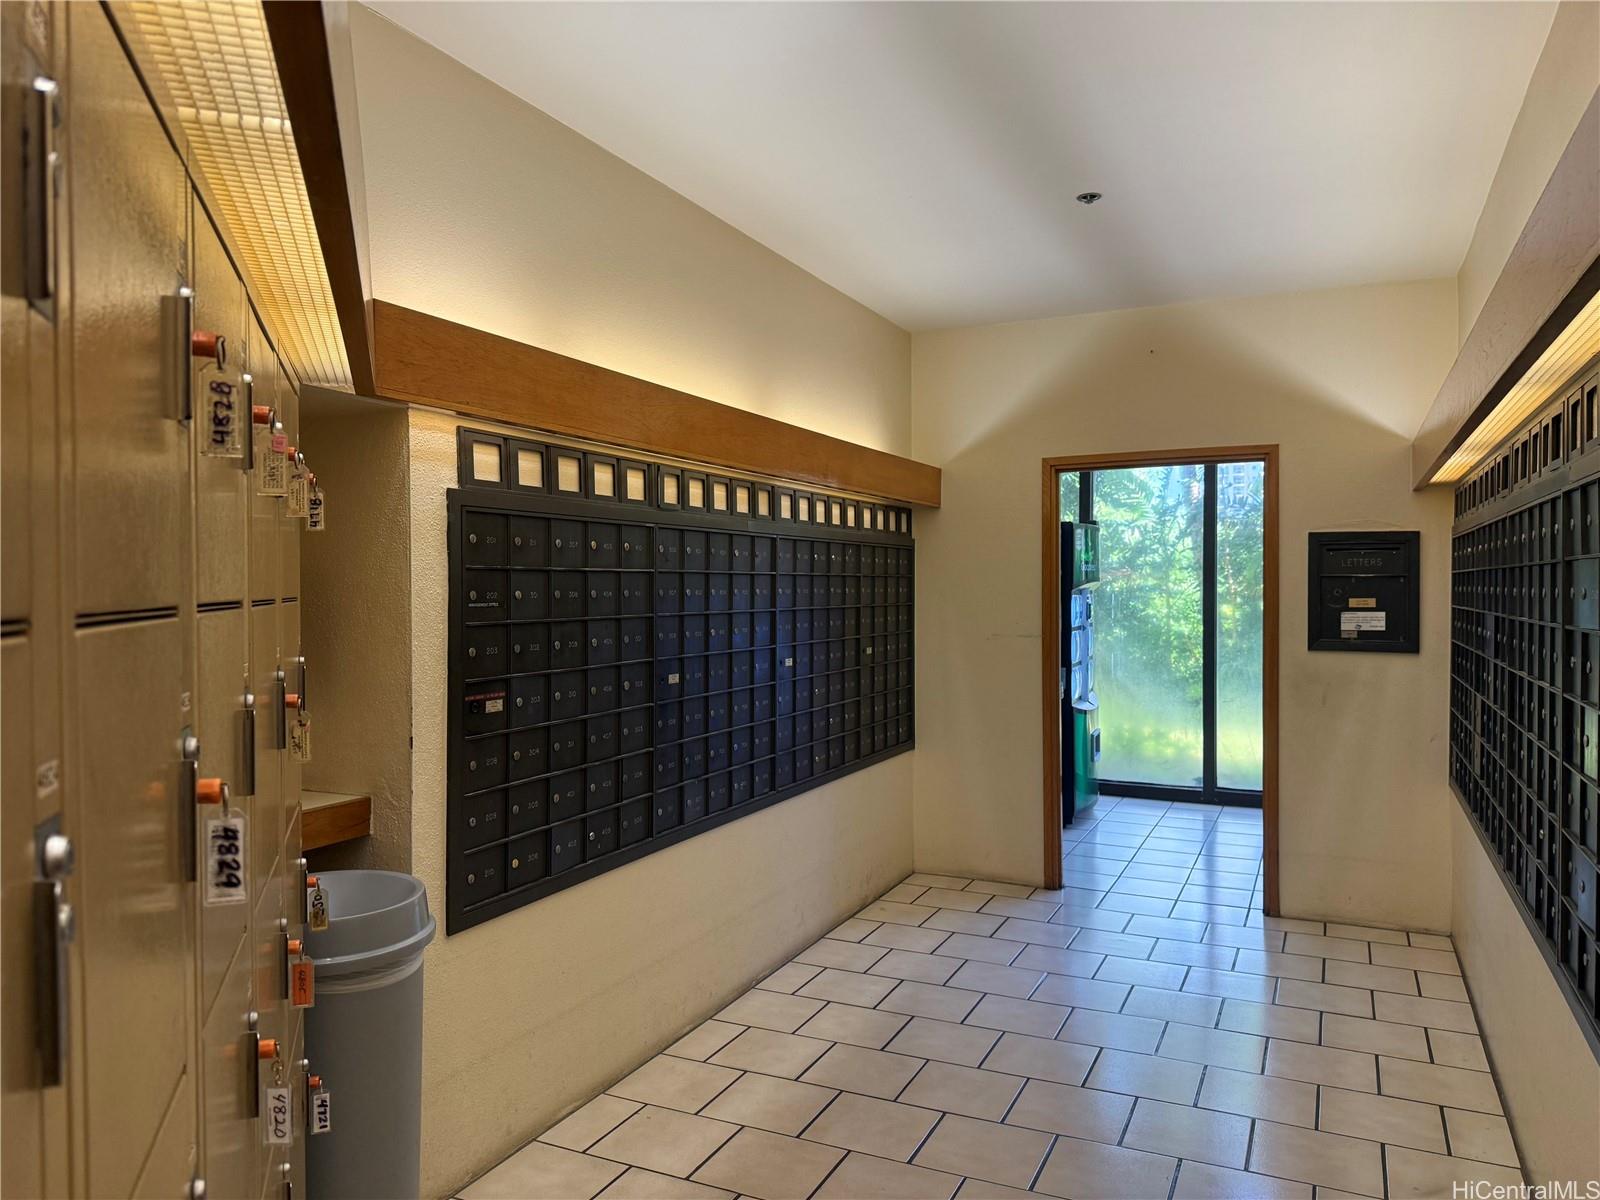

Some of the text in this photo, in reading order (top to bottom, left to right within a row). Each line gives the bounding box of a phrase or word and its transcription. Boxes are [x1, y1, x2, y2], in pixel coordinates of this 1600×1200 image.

[209, 379, 235, 445] 4828
[309, 498, 322, 528] 4718
[1341, 558, 1383, 568] LETTERS
[213, 826, 242, 888] 4829
[272, 1093, 287, 1138] 4820
[317, 1099, 329, 1130] 4721
